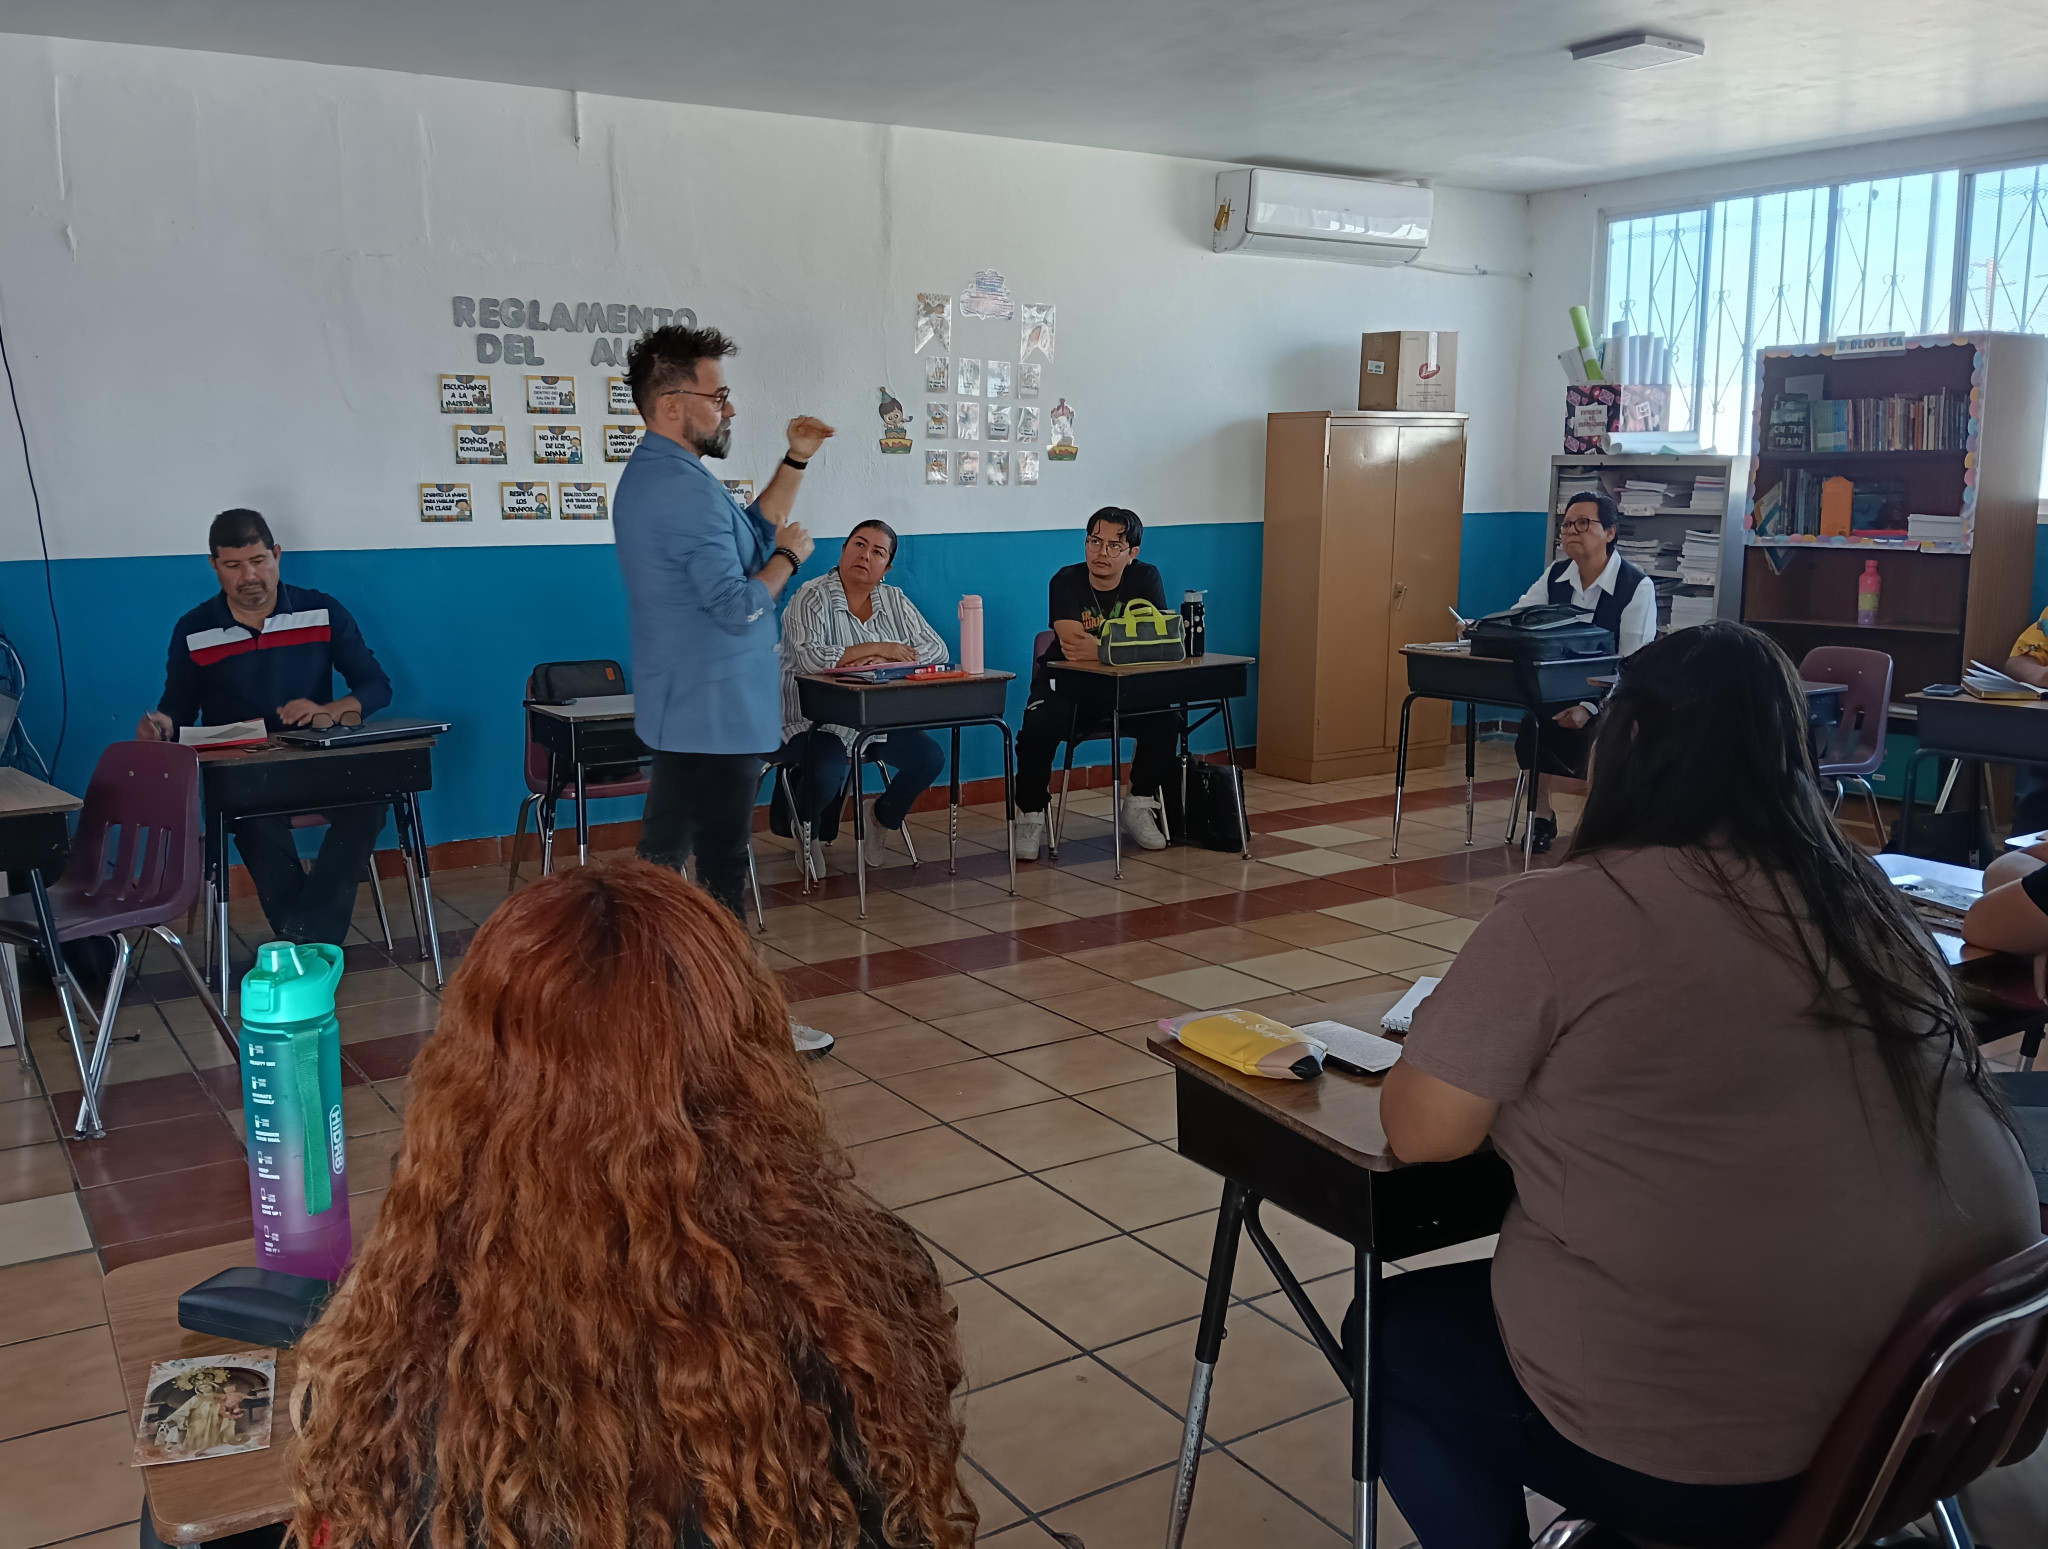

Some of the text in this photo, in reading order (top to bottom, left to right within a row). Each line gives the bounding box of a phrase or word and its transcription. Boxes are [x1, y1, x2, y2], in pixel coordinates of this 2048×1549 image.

[452, 295, 698, 333] REGLAMENTO
[476, 333, 632, 367] DEL AU
[443, 383, 487, 392] ESCUCHAMOS
[1773, 425, 1805, 434] ON THE
[459, 436, 488, 445] SOMOS
[1775, 437, 1802, 446] TRAIN
